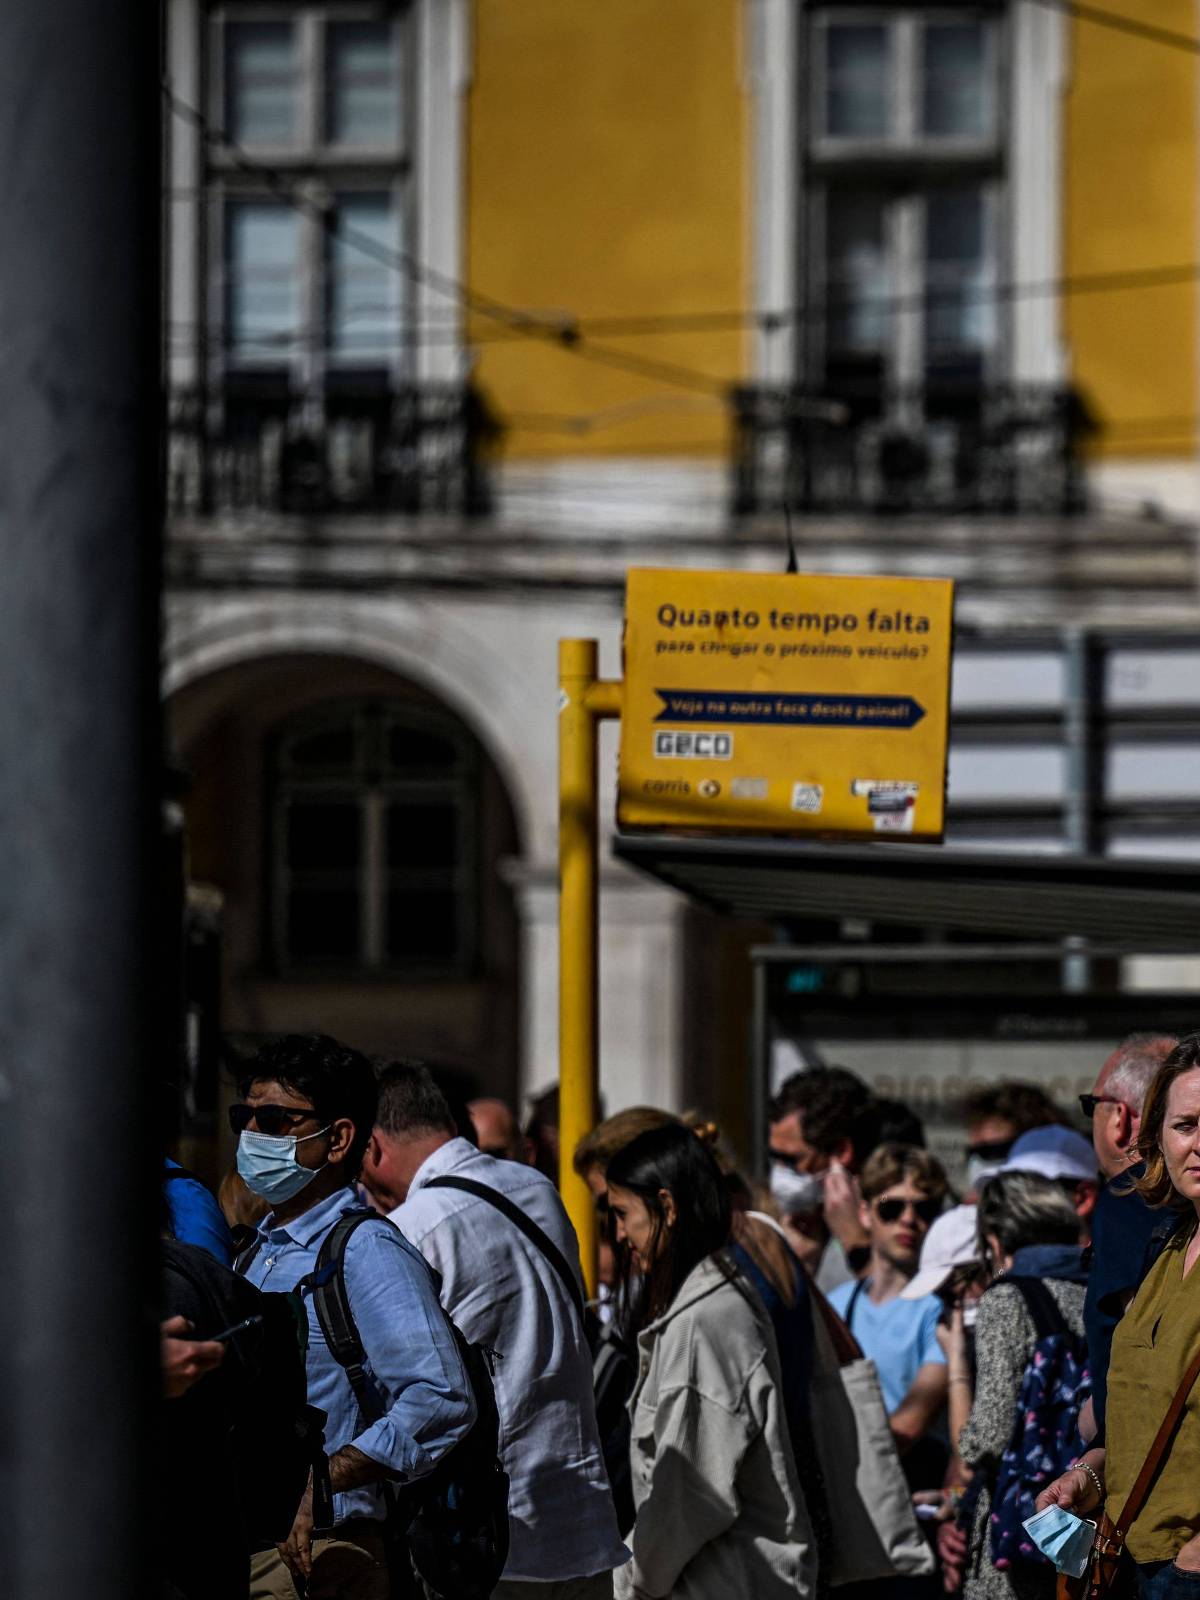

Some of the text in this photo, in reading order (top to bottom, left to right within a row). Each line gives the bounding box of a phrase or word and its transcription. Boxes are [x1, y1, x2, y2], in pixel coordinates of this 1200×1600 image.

[657, 603, 930, 637] Quanto tempo falta
[656, 640, 695, 656] para
[763, 643, 777, 656] o
[671, 698, 704, 717] Veja
[729, 700, 773, 716] outra
